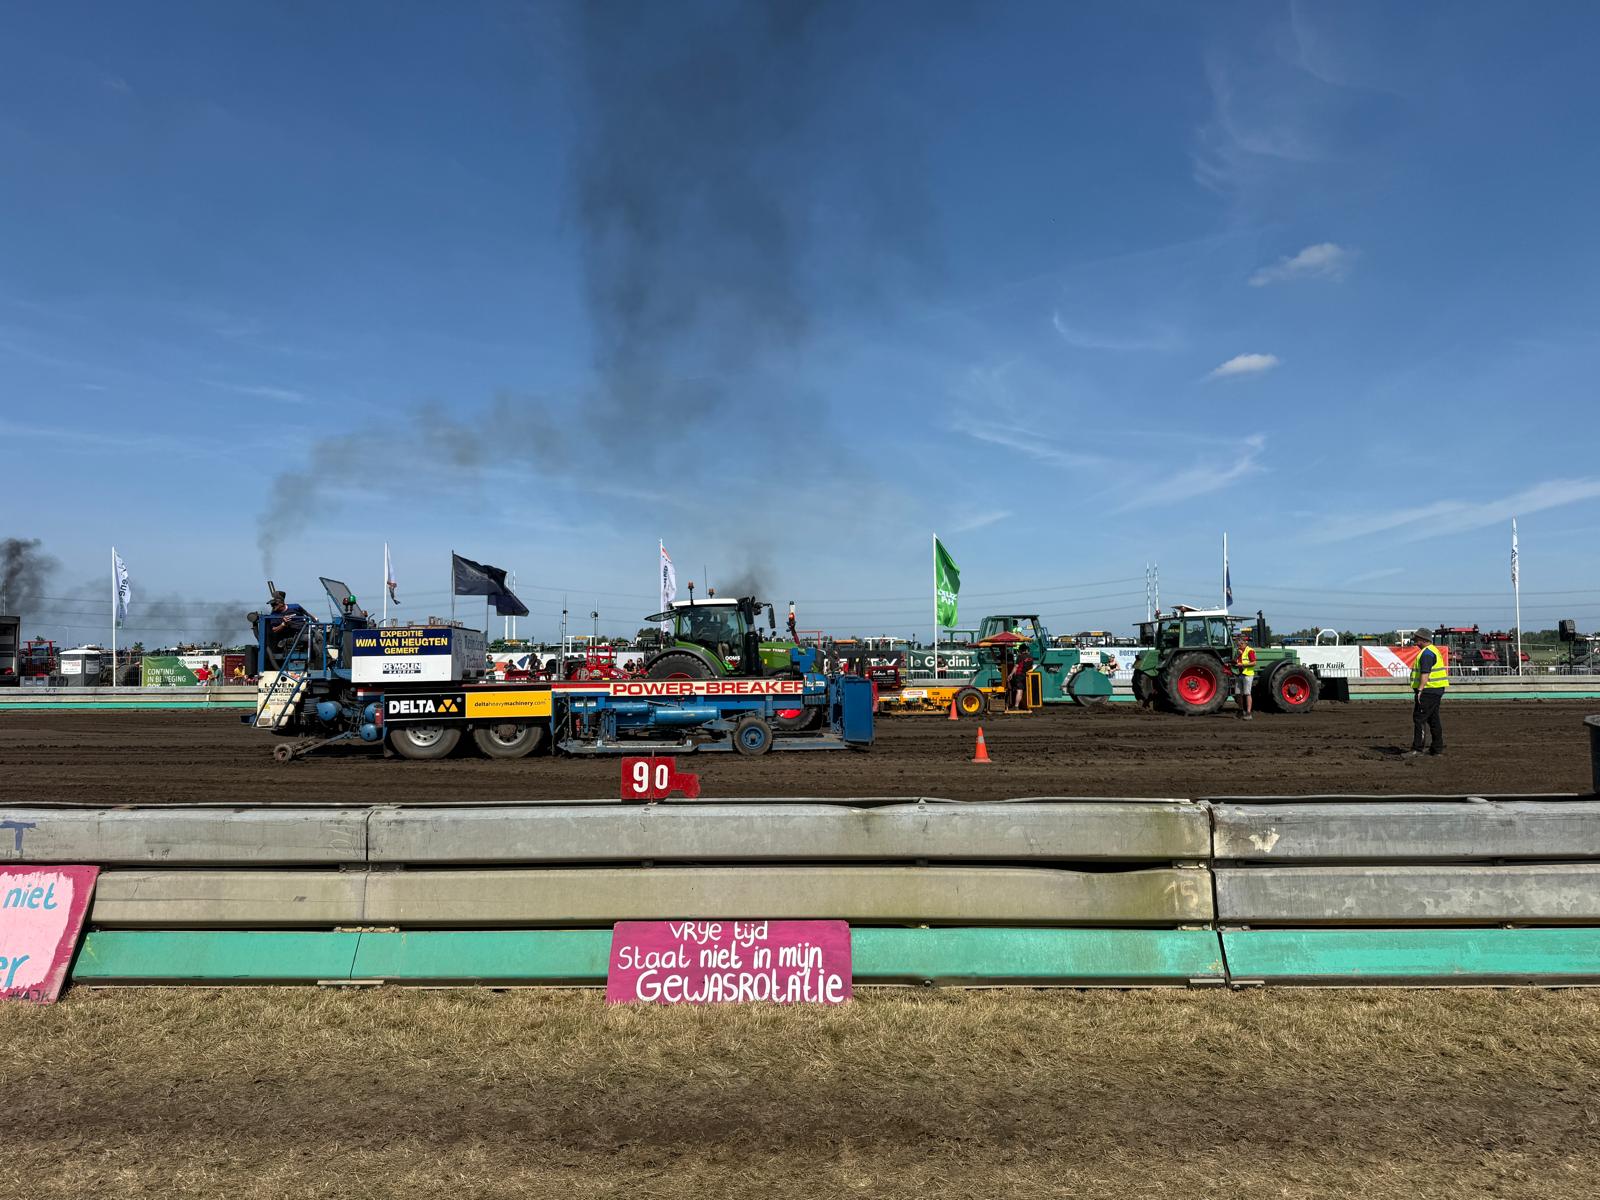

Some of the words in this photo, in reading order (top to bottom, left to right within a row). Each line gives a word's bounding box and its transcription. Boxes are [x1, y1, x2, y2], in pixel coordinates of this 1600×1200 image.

[380, 630, 424, 638] EXPEDITIE
[355, 638, 377, 648] WIM
[379, 638, 399, 647] VAN
[401, 637, 448, 647] HEUGTEN
[384, 647, 420, 655] GEMERT
[613, 681, 803, 696] POWER-BREAKER
[389, 700, 436, 714] DELTA
[474, 699, 546, 708] deltaheavymachinery.com
[632, 761, 669, 792] 90
[4, 882, 58, 910] niet
[735, 920, 768, 947] tijd
[617, 944, 691, 969] Staat
[699, 940, 742, 968] niet
[753, 945, 771, 968] in
[779, 942, 822, 976] mijn
